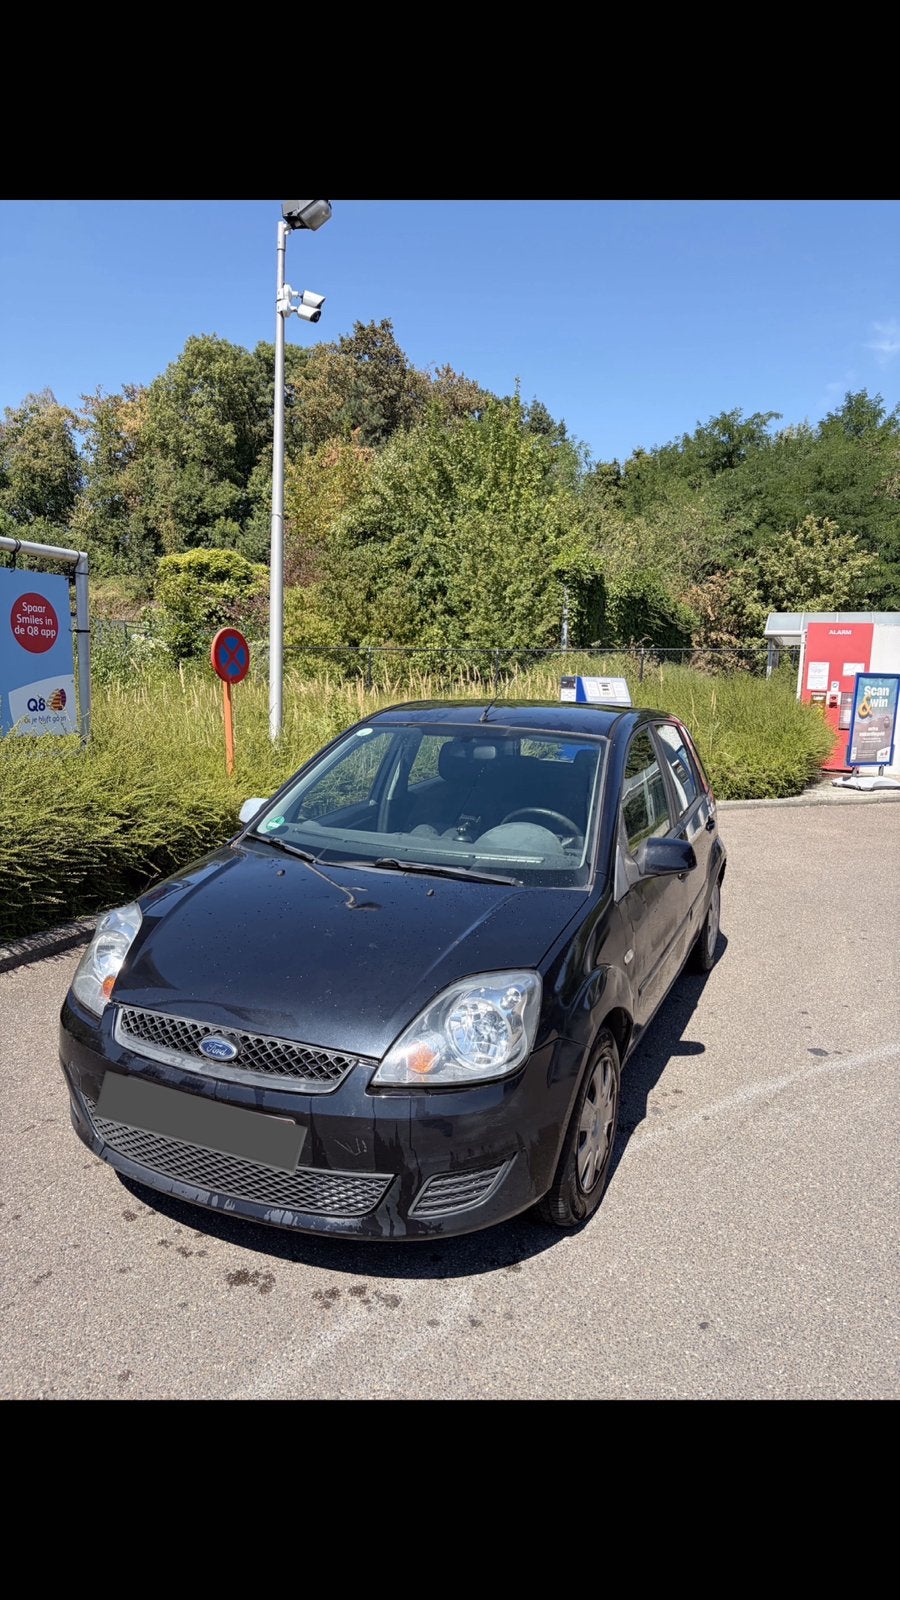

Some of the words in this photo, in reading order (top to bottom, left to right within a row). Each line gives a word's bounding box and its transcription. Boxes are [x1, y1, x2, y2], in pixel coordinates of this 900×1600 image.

[22, 601, 46, 613] Spaar
[16, 613, 44, 625] Smiles
[45, 616, 53, 626] in
[14, 625, 25, 635] de
[27, 626, 39, 637] Q8
[40, 629, 56, 638] app
[864, 685, 890, 697] Scan
[27, 697, 46, 712] Q8
[871, 696, 888, 708] win
[206, 1043, 227, 1056] Ford
